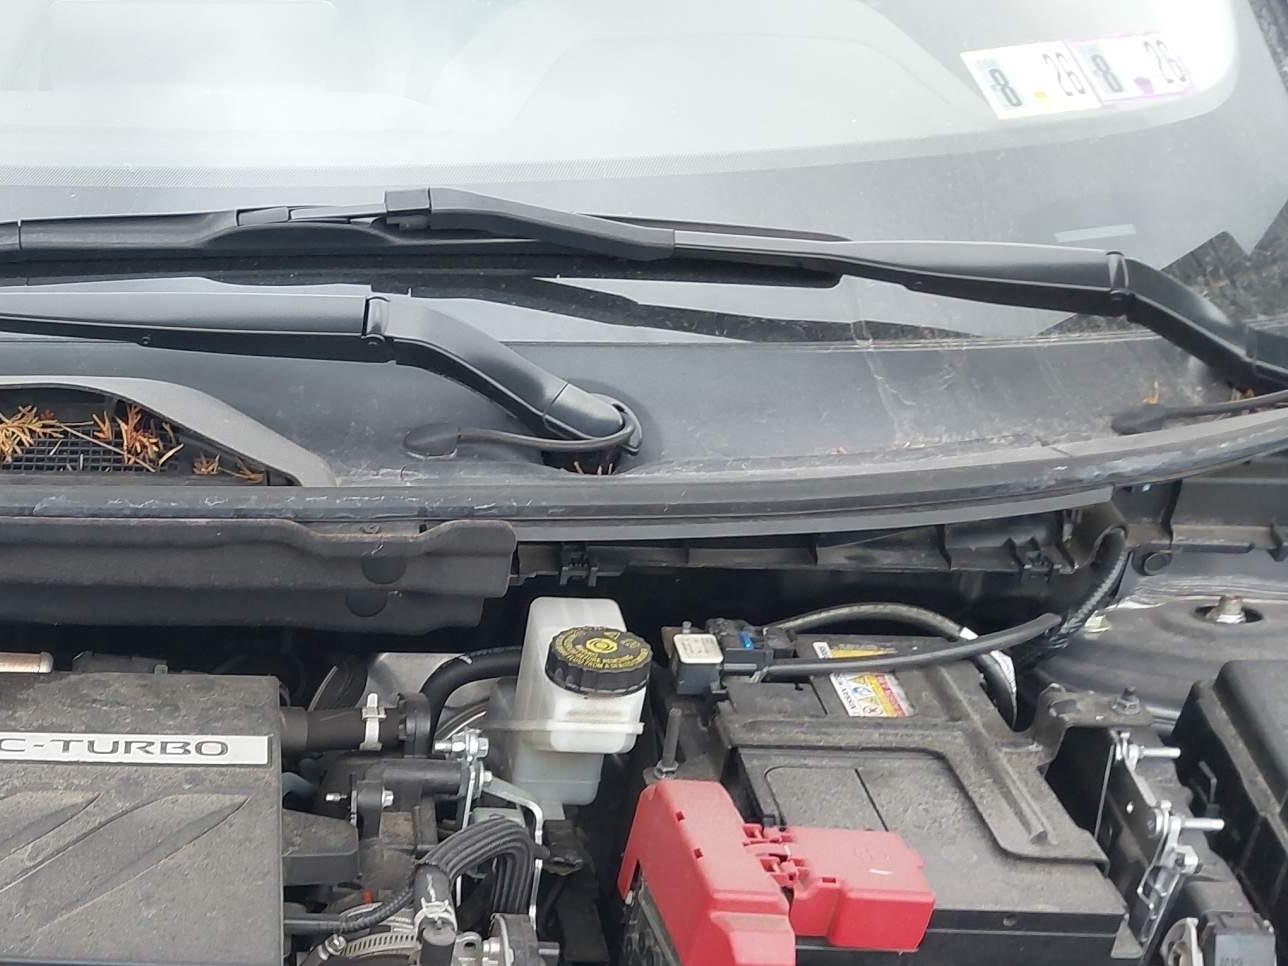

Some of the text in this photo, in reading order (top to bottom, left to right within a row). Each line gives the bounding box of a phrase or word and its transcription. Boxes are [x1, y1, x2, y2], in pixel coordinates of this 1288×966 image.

[989, 52, 1086, 107] 8 26
[1091, 54, 1124, 93] 8
